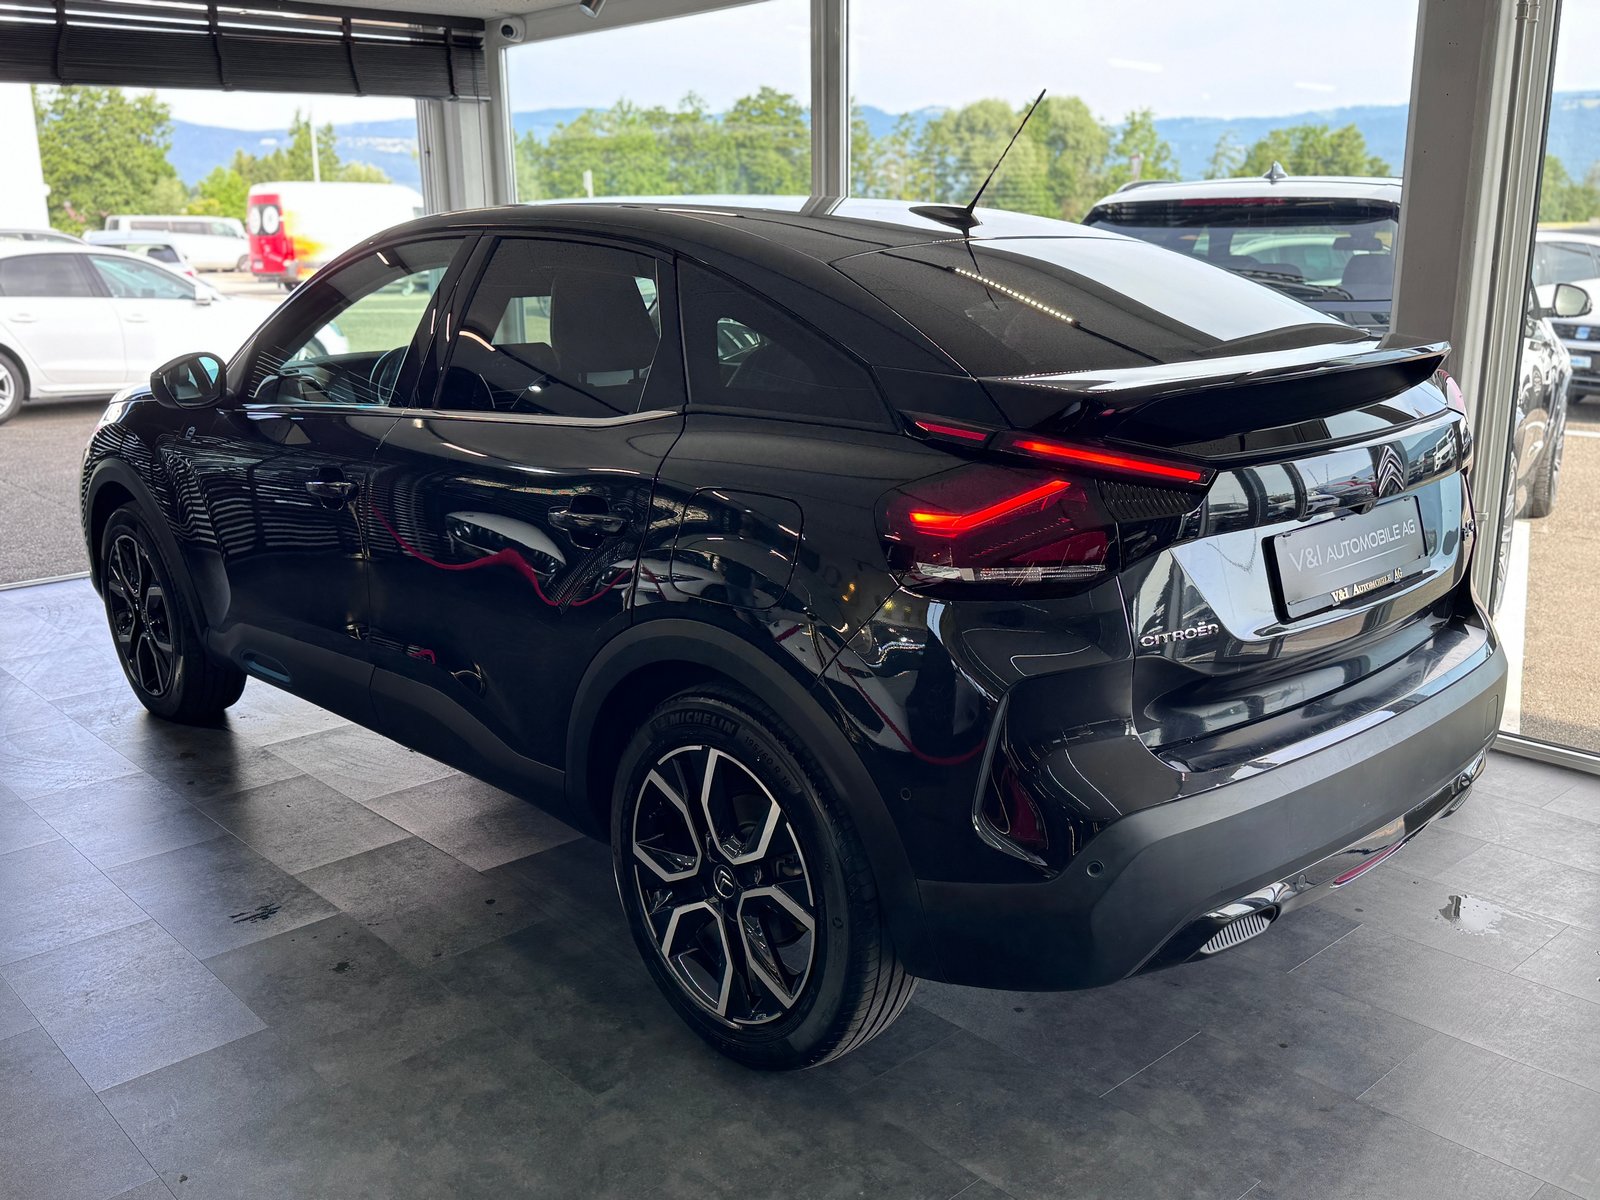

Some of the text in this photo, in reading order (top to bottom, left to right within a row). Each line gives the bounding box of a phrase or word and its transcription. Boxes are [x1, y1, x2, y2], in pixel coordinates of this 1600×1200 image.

[1289, 519, 1416, 572] V&I AUTOMOBILE AG
[1331, 587, 1349, 602] V&I
[1394, 567, 1403, 580] AG
[669, 711, 737, 735] MICHELIN
[744, 735, 774, 765] 195/60
